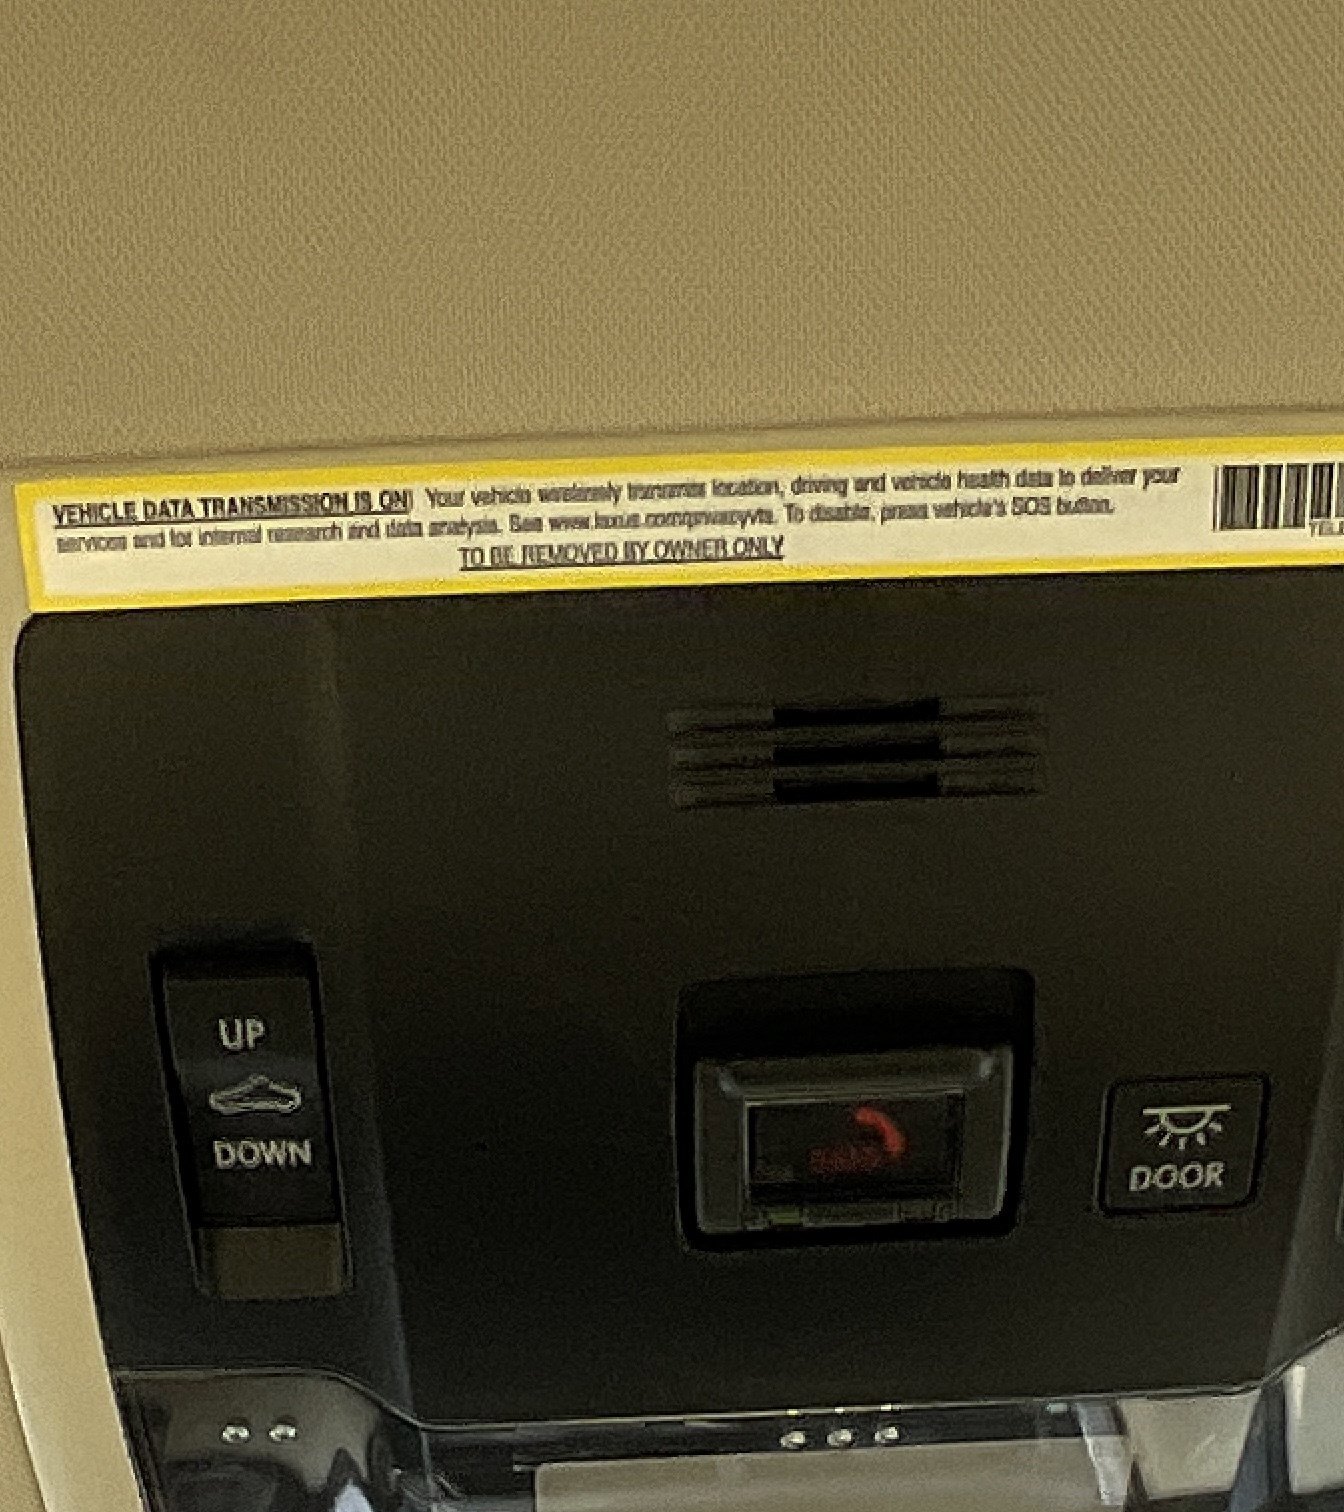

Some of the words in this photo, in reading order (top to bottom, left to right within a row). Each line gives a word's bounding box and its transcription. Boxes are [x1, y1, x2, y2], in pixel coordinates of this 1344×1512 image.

[52, 501, 137, 526] VEHICLE
[143, 498, 195, 521] DATA
[197, 491, 348, 520] TRANSMISSION
[354, 490, 371, 513] IS
[425, 487, 465, 508] Your
[471, 486, 531, 507] vehicle
[791, 475, 849, 498] driving
[853, 473, 886, 493] and
[891, 471, 952, 492] vehicle
[957, 468, 1009, 490] health
[1015, 467, 1054, 488] data
[1058, 468, 1076, 487] to
[1080, 465, 1138, 486] deliver
[1142, 467, 1181, 491] your
[133, 528, 165, 549] and
[347, 519, 380, 540] and
[386, 519, 423, 538] data
[783, 503, 804, 523] To
[1011, 496, 1052, 515] SOS
[457, 546, 485, 568] TO
[491, 544, 514, 566] BE
[520, 541, 617, 566] REMOVED
[624, 540, 649, 562] BY
[654, 538, 727, 561] OWNER
[733, 535, 785, 560] ONLY
[218, 1017, 265, 1050] UP
[212, 1139, 312, 1169] DOWN
[1129, 1161, 1226, 1192] DOOR
